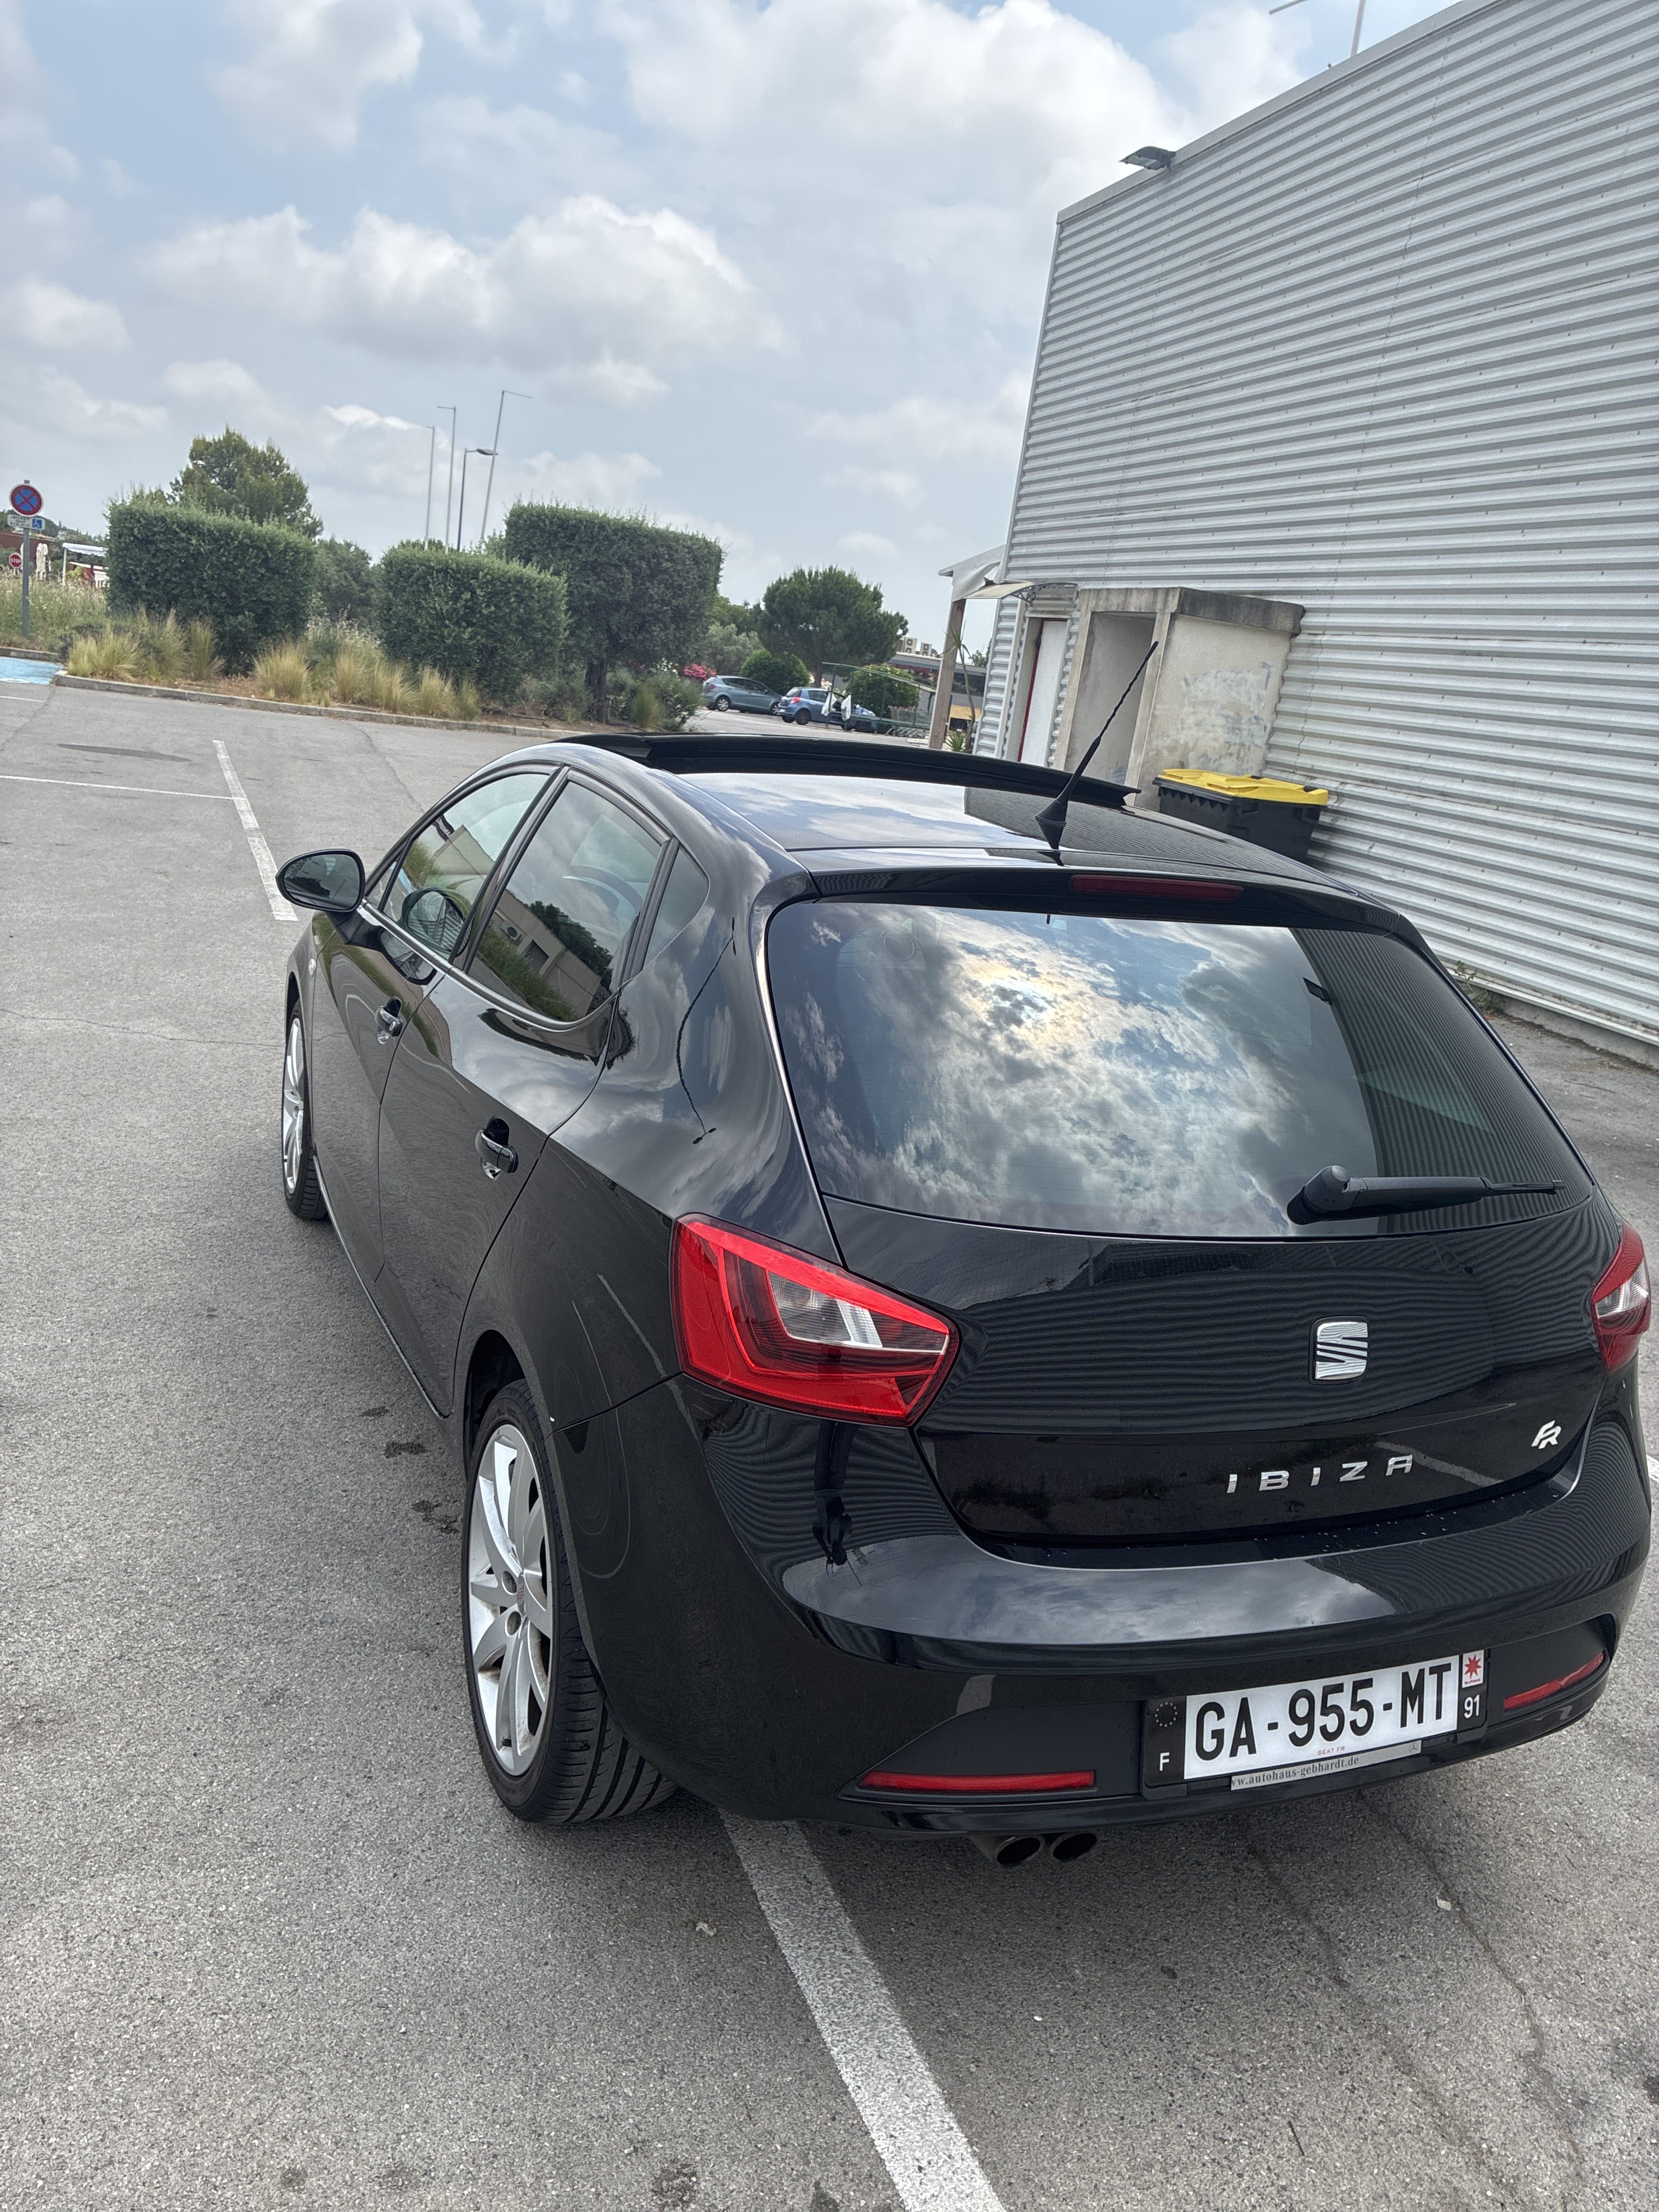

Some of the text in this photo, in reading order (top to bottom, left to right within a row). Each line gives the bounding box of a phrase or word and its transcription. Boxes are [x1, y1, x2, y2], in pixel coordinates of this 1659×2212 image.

[1227, 1454, 1413, 1494] IBIZA
[1195, 1662, 1452, 1761] GA-955-MT
[1464, 1694, 1480, 1719] 91
[1159, 1752, 1170, 1771] F
